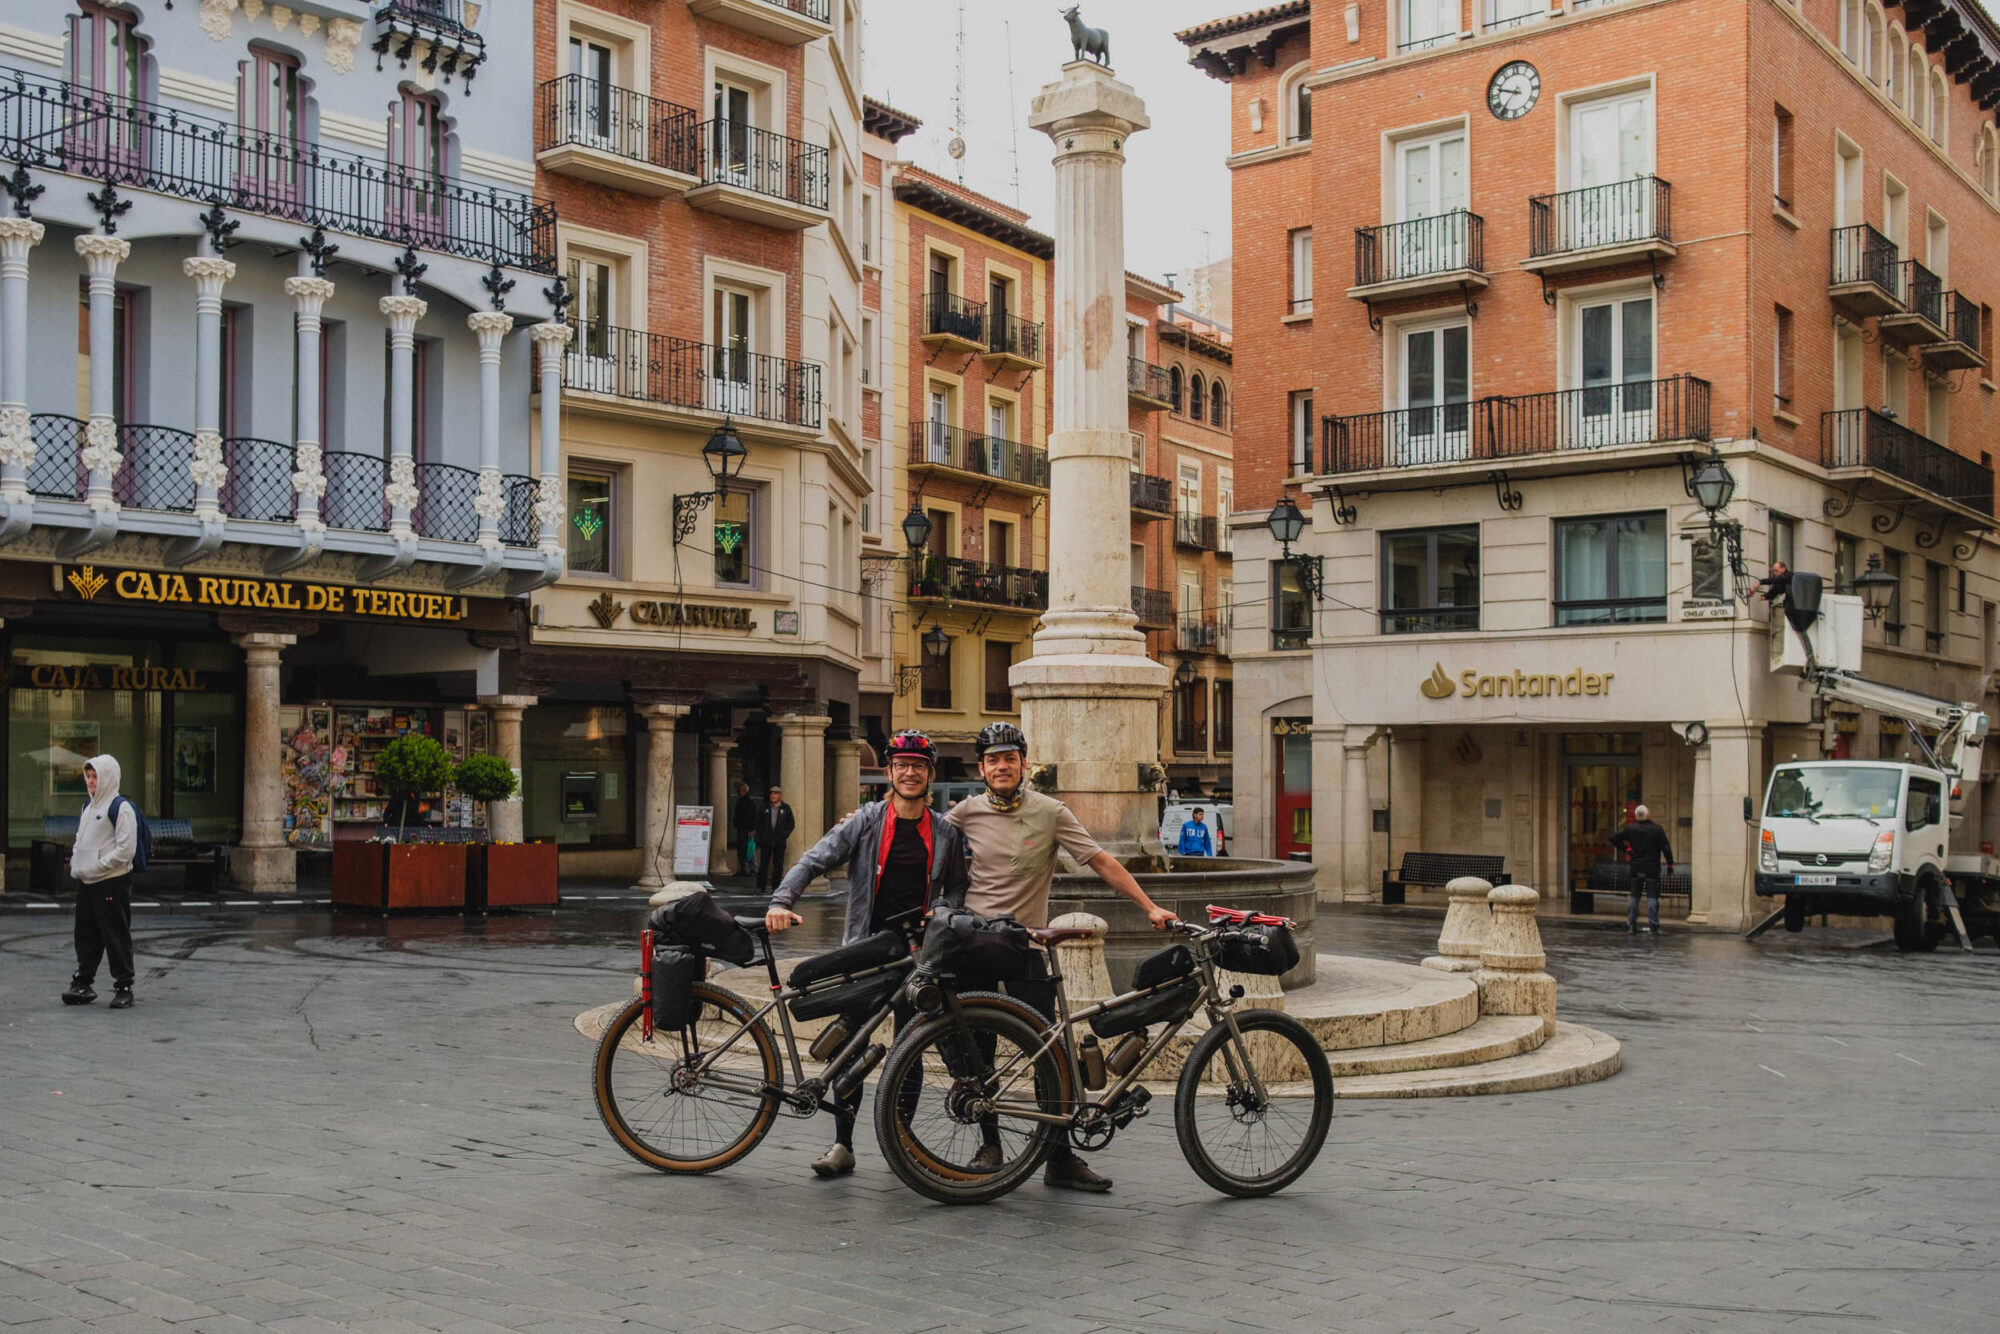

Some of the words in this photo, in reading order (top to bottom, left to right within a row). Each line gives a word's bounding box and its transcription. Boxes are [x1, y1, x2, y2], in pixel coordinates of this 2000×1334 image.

[115, 570, 193, 602] CAJA
[198, 577, 301, 609] RURAL
[305, 585, 344, 612] DE
[352, 589, 461, 621] TERUEL
[629, 601, 684, 626] CAJA
[684, 603, 757, 630] RURAL
[31, 664, 101, 689] CAJA
[111, 667, 206, 691] RURAL
[1460, 667, 1615, 698] Santander
